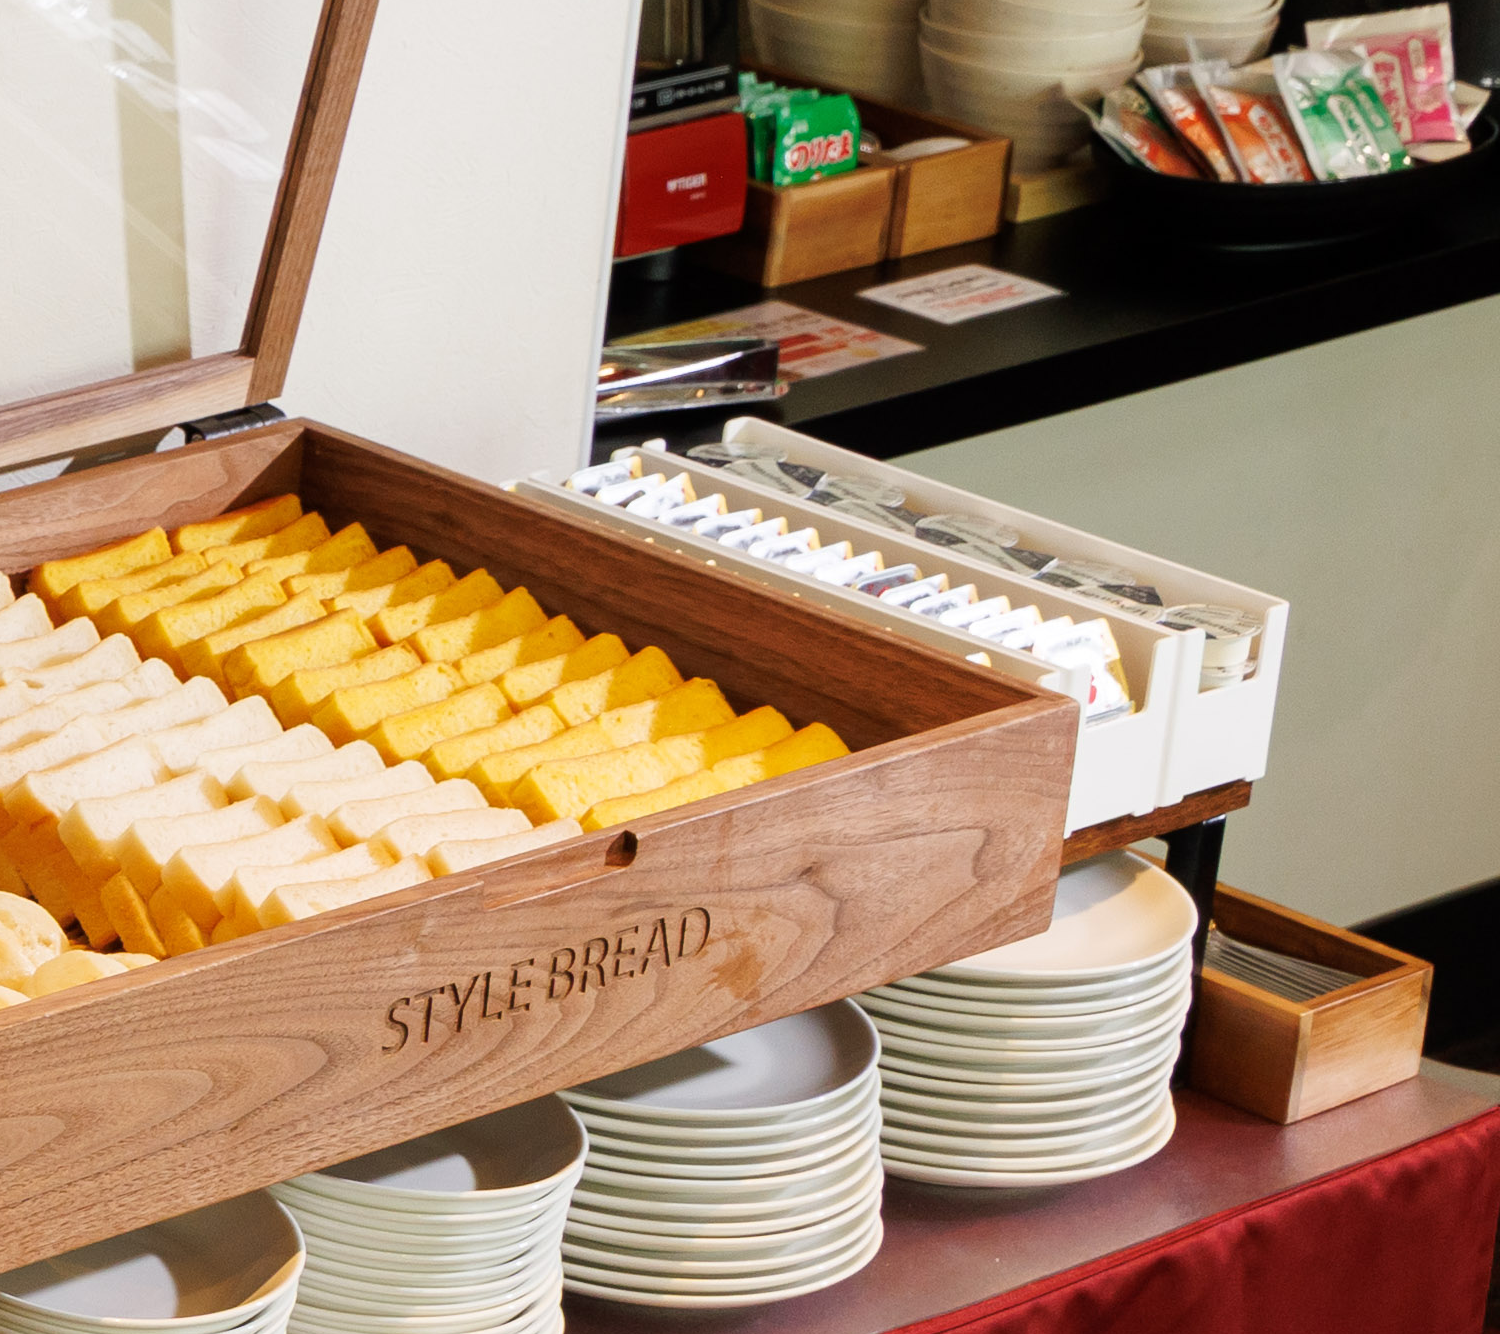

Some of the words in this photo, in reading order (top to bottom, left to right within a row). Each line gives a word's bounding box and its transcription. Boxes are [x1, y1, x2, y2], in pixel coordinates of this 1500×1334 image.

[785, 130, 853, 172] のりたま
[676, 172, 707, 189] TIGER
[381, 958, 535, 1055] STYLE
[546, 906, 712, 1003] BREAD
